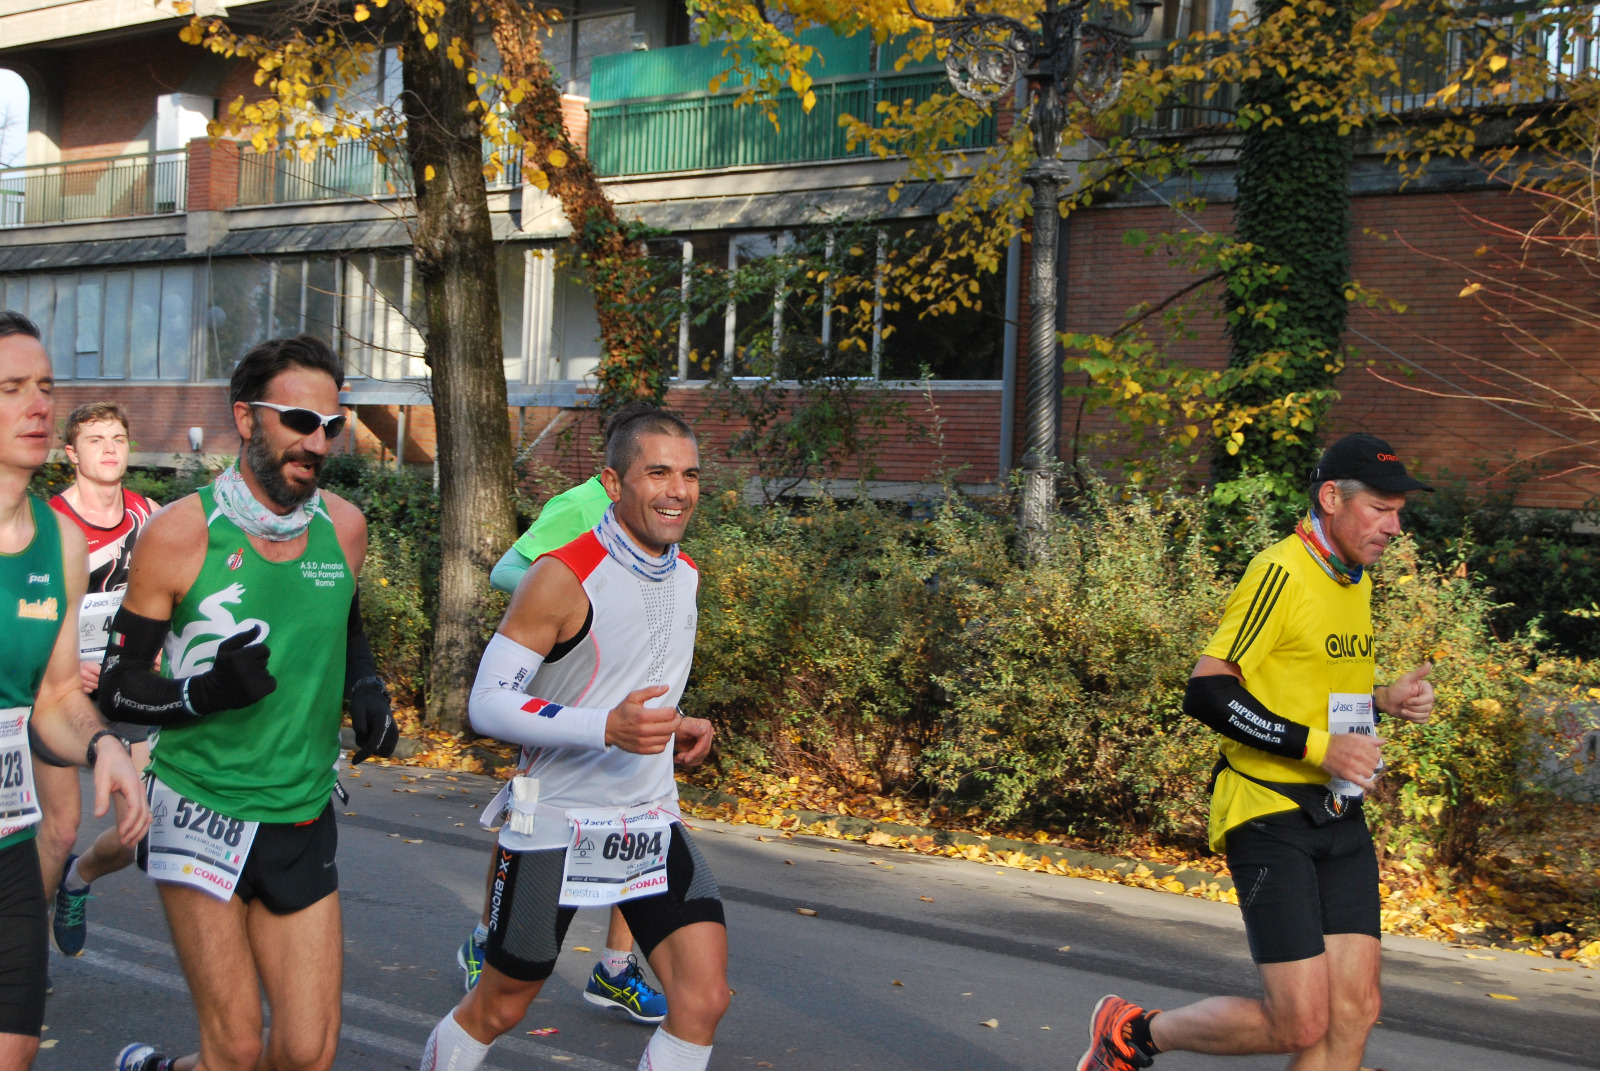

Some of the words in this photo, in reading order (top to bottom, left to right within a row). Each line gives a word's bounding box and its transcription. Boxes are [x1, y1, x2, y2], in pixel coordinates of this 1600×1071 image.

[300, 562, 320, 570] A.S.D.
[302, 570, 317, 578] Villa
[318, 570, 345, 580] Pamphili
[315, 579, 336, 587] Roma
[92, 599, 109, 608] asics
[514, 667, 528, 682] 2011
[1227, 699, 1272, 731] IMPERIAL
[1339, 703, 1354, 712] asics
[0, 750, 24, 789] 23
[173, 797, 246, 848] 5268
[602, 831, 663, 862] 6984
[193, 867, 233, 891] CONAD
[629, 875, 667, 891] CONAD
